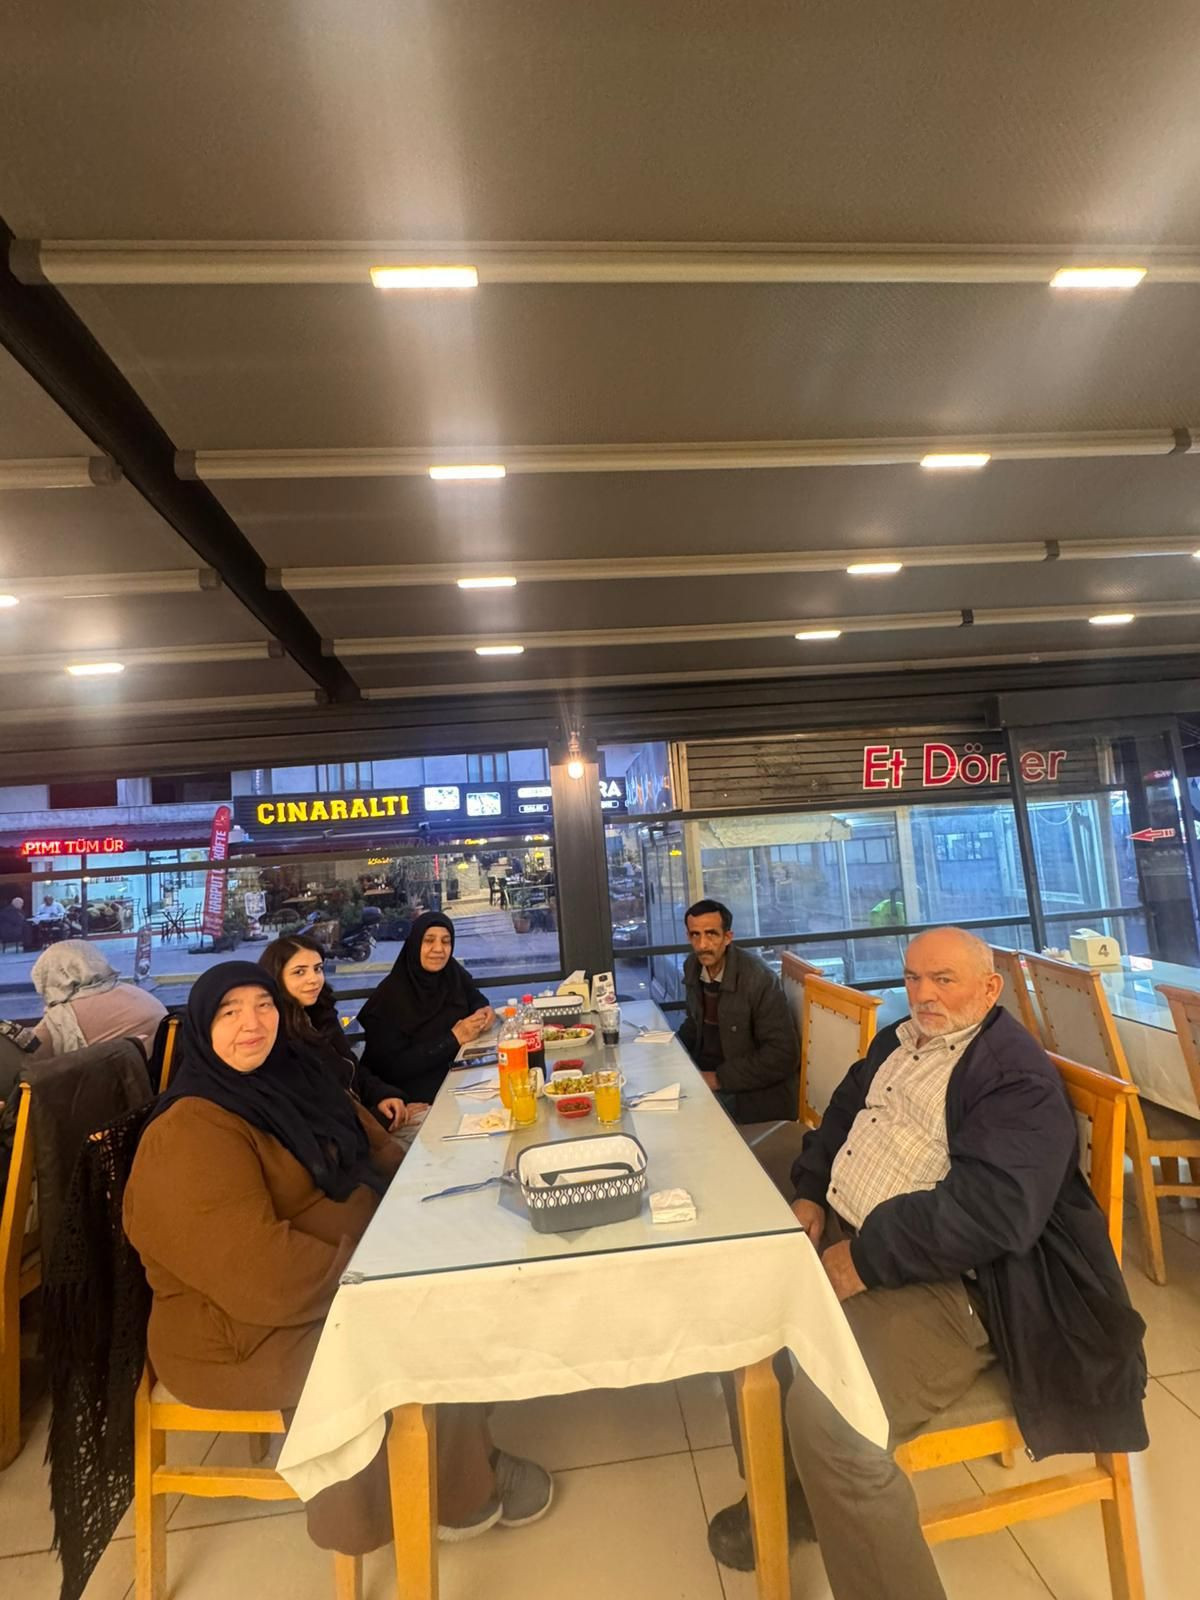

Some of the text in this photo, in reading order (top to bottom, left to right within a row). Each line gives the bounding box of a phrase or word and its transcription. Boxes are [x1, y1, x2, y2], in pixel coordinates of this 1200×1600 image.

[863, 745, 907, 789] Et
[64, 838, 99, 853] TÜM
[212, 830, 227, 861] KÖFTE
[1098, 944, 1110, 957] 4
